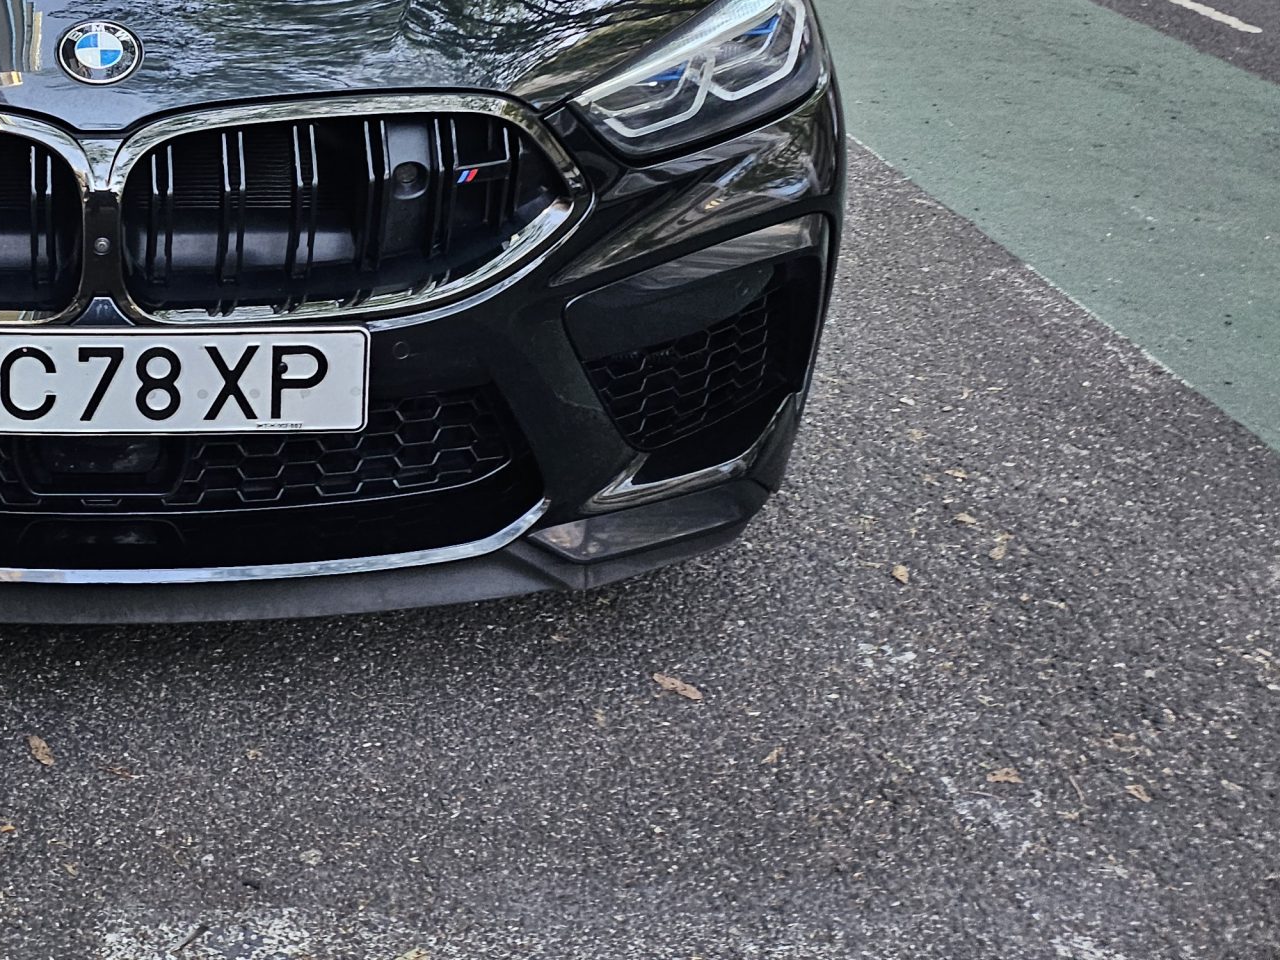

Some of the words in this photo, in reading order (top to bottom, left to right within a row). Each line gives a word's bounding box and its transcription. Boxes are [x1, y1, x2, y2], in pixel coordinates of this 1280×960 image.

[67, 24, 131, 41] BMW
[77, 346, 182, 421] 78
[203, 344, 329, 421] XP
